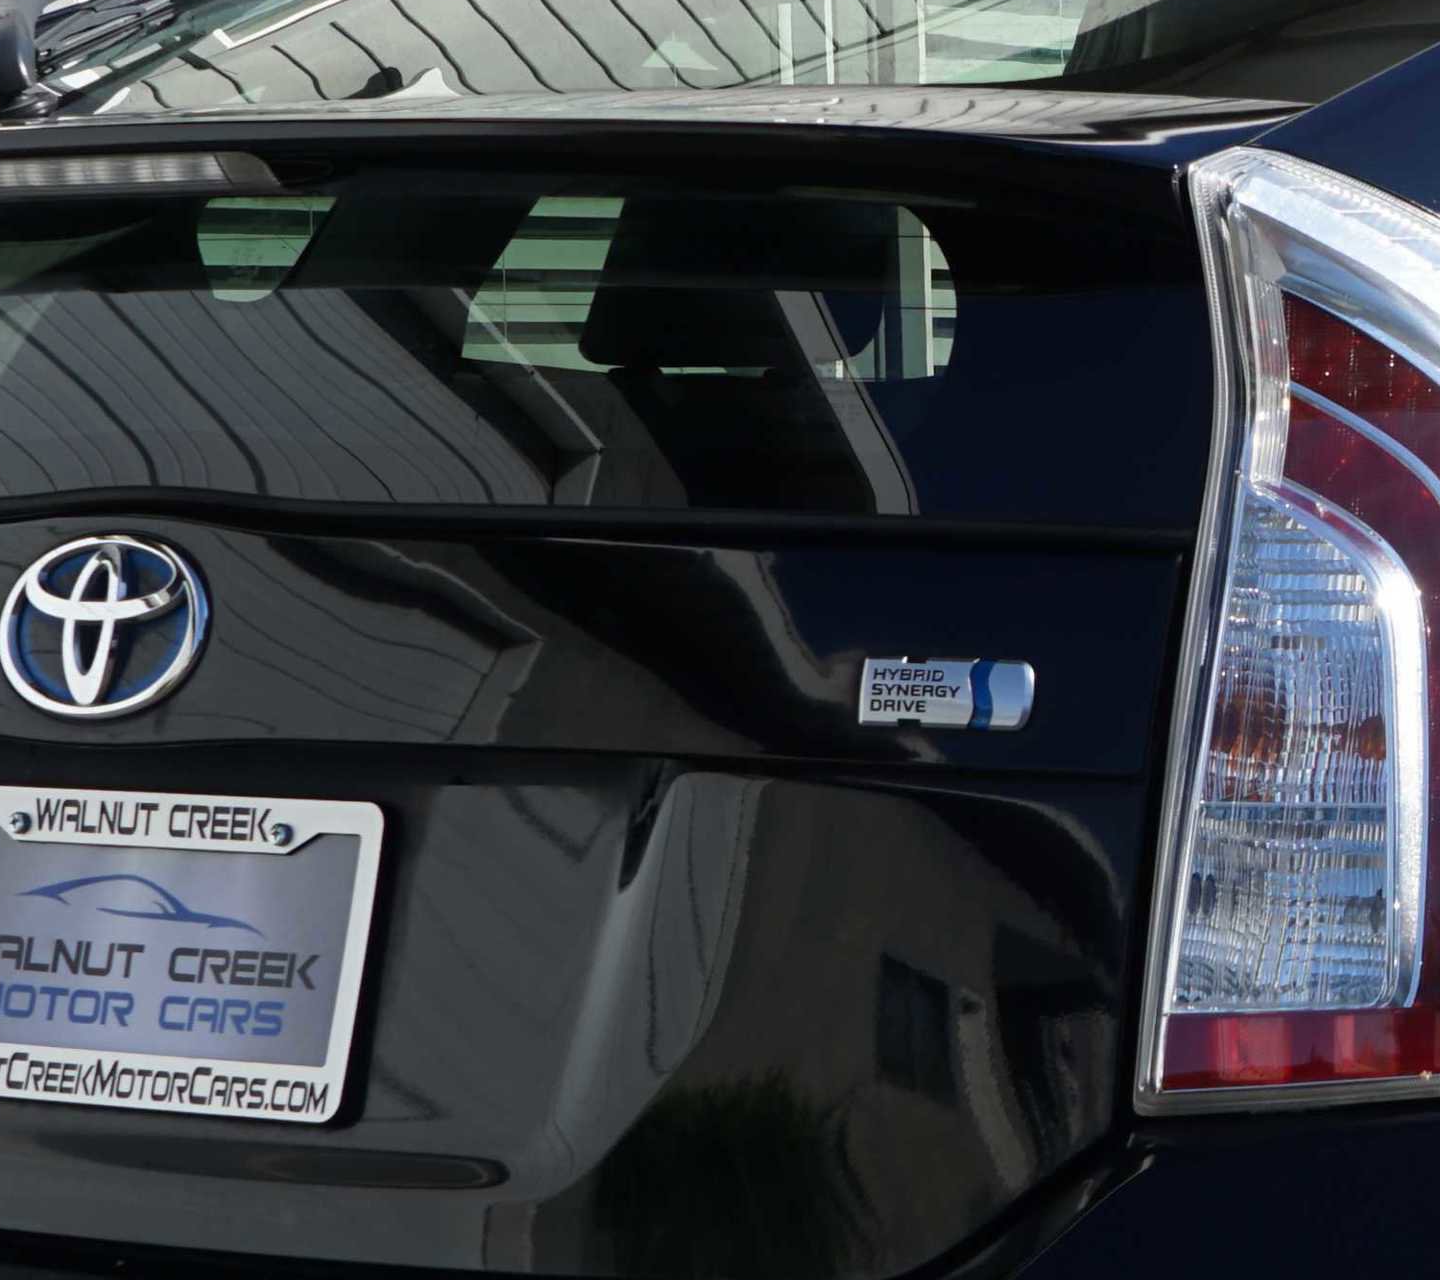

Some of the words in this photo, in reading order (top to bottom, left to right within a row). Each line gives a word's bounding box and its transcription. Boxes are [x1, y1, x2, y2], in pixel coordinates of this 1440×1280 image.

[873, 667, 945, 683] HYBRID
[871, 683, 961, 699] SYNERGY
[869, 698, 928, 714] DRIVE
[35, 796, 160, 837] WALNUT
[167, 803, 273, 843] CREEK
[166, 946, 322, 991] CREEK
[158, 995, 286, 1037] CARS
